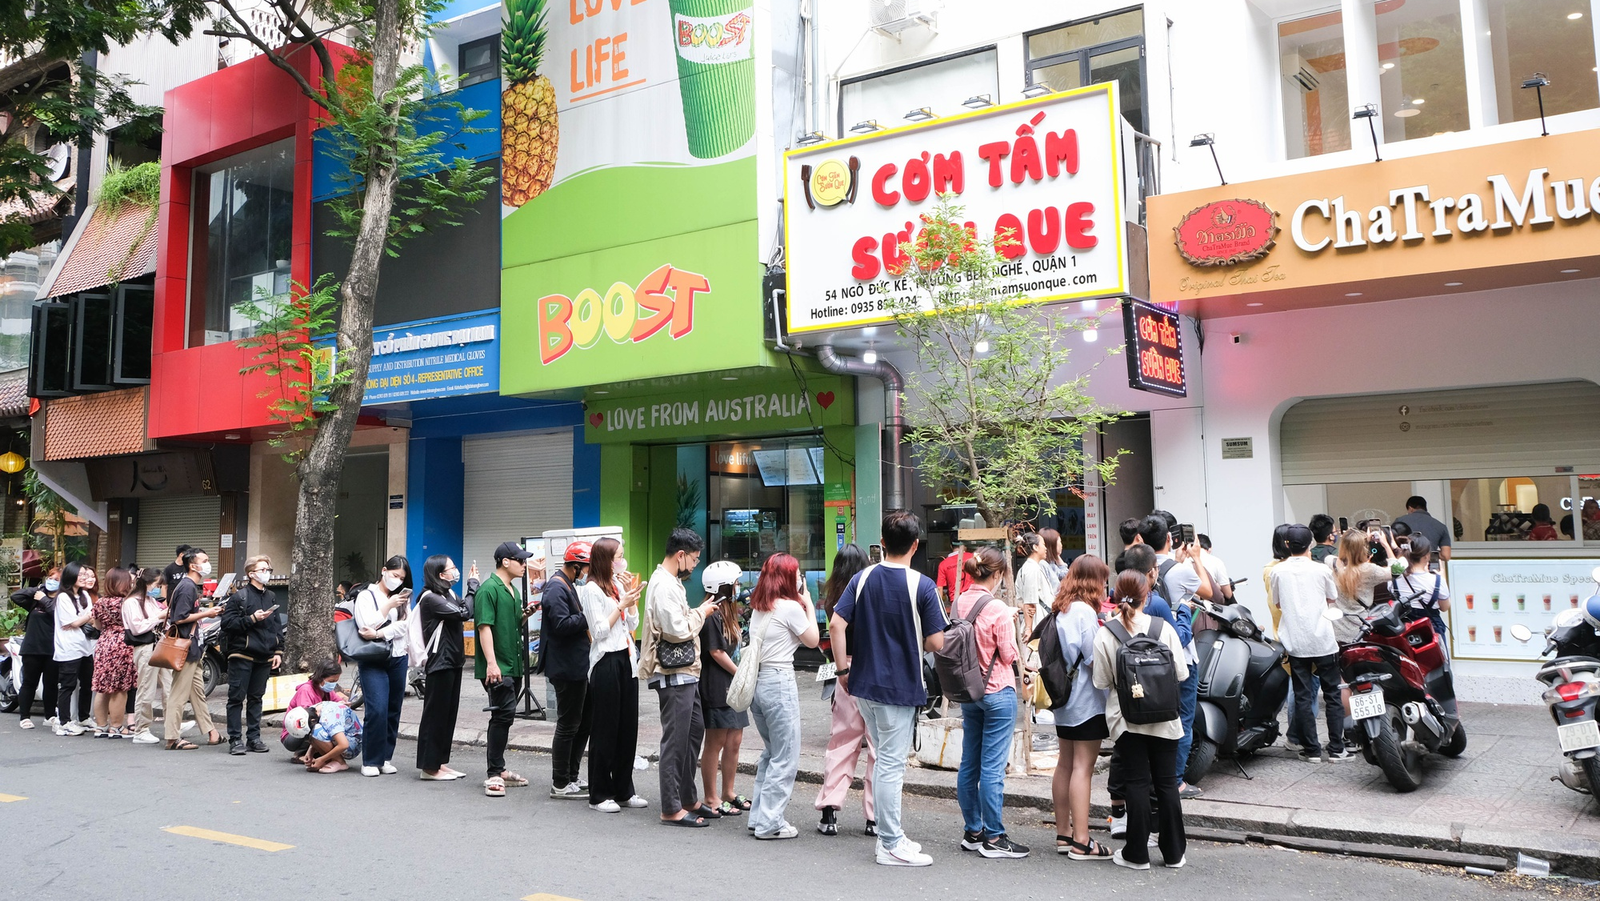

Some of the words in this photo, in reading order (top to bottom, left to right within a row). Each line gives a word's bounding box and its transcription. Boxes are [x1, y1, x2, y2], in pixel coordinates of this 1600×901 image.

[678, 12, 751, 48] BOOST
[570, 32, 629, 93] LIFE
[871, 151, 965, 206] CƠM
[978, 111, 1081, 188] TẤM
[994, 201, 1099, 260] QUE
[825, 289, 837, 301] 54
[841, 283, 864, 299] NGÔ
[1033, 255, 1066, 273] QUẬN
[1071, 255, 1076, 267] 1
[1180, 273, 1227, 296] Original
[1229, 267, 1259, 286] Thai
[1261, 264, 1286, 283] Tea
[538, 263, 711, 366] BOOST
[811, 306, 848, 319] Hotline:
[851, 301, 874, 314] 0935
[383, 362, 393, 371] AND
[394, 358, 424, 370] DISTRIBUTION
[425, 355, 444, 366] NITRILE
[445, 352, 465, 363] MEDICAL
[467, 350, 485, 360] GLOVES
[463, 365, 484, 378] OFFICE
[606, 407, 646, 432] LOVE
[651, 401, 699, 427] FROM
[705, 390, 812, 423] AUSTRALIA
[715, 450, 735, 465] love
[202, 479, 212, 489] 62
[1562, 574, 1595, 585] Spec
[1354, 694, 1378, 707] 66-S1
[1354, 704, 1383, 718] 555.18
